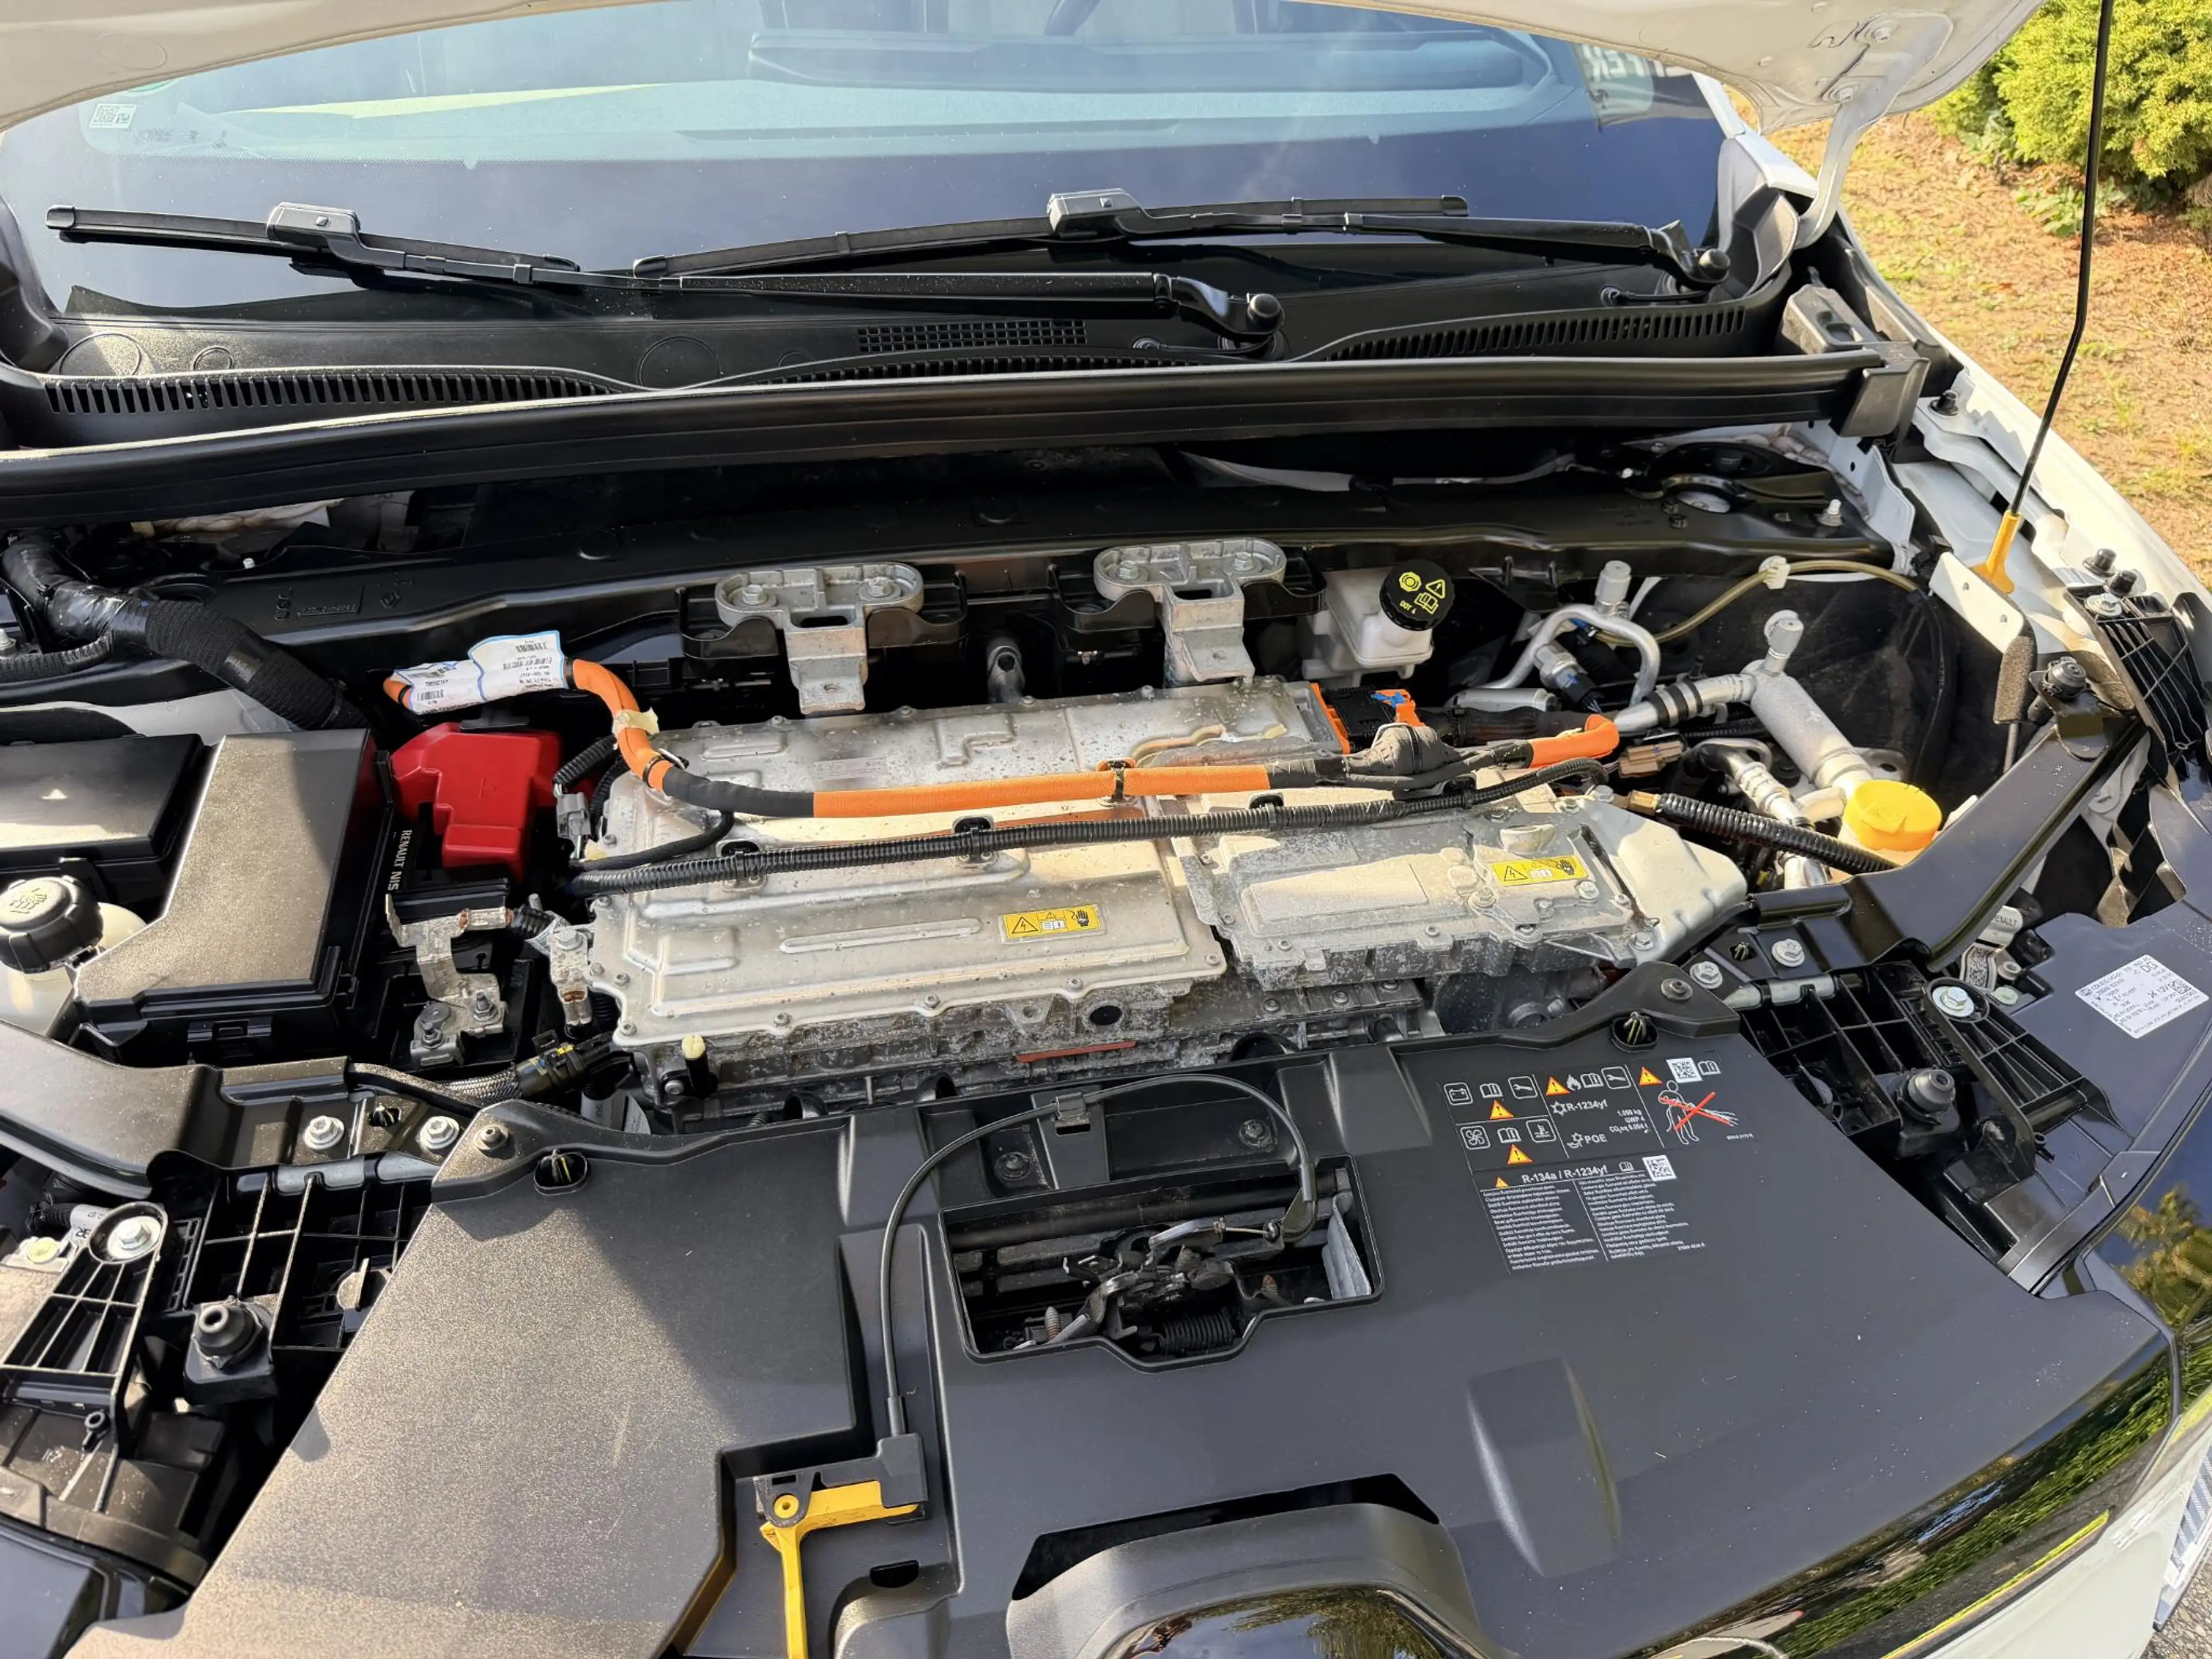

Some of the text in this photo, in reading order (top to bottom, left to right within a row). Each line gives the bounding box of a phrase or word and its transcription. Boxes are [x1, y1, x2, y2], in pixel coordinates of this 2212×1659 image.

[1400, 600, 1412, 611] DOT
[394, 830, 412, 868] RENAULT
[1567, 1099, 1608, 1111] R-1234yf
[1584, 1134, 1607, 1143] POE
[1521, 1165, 1608, 1184] R-134a / R-1234yf
